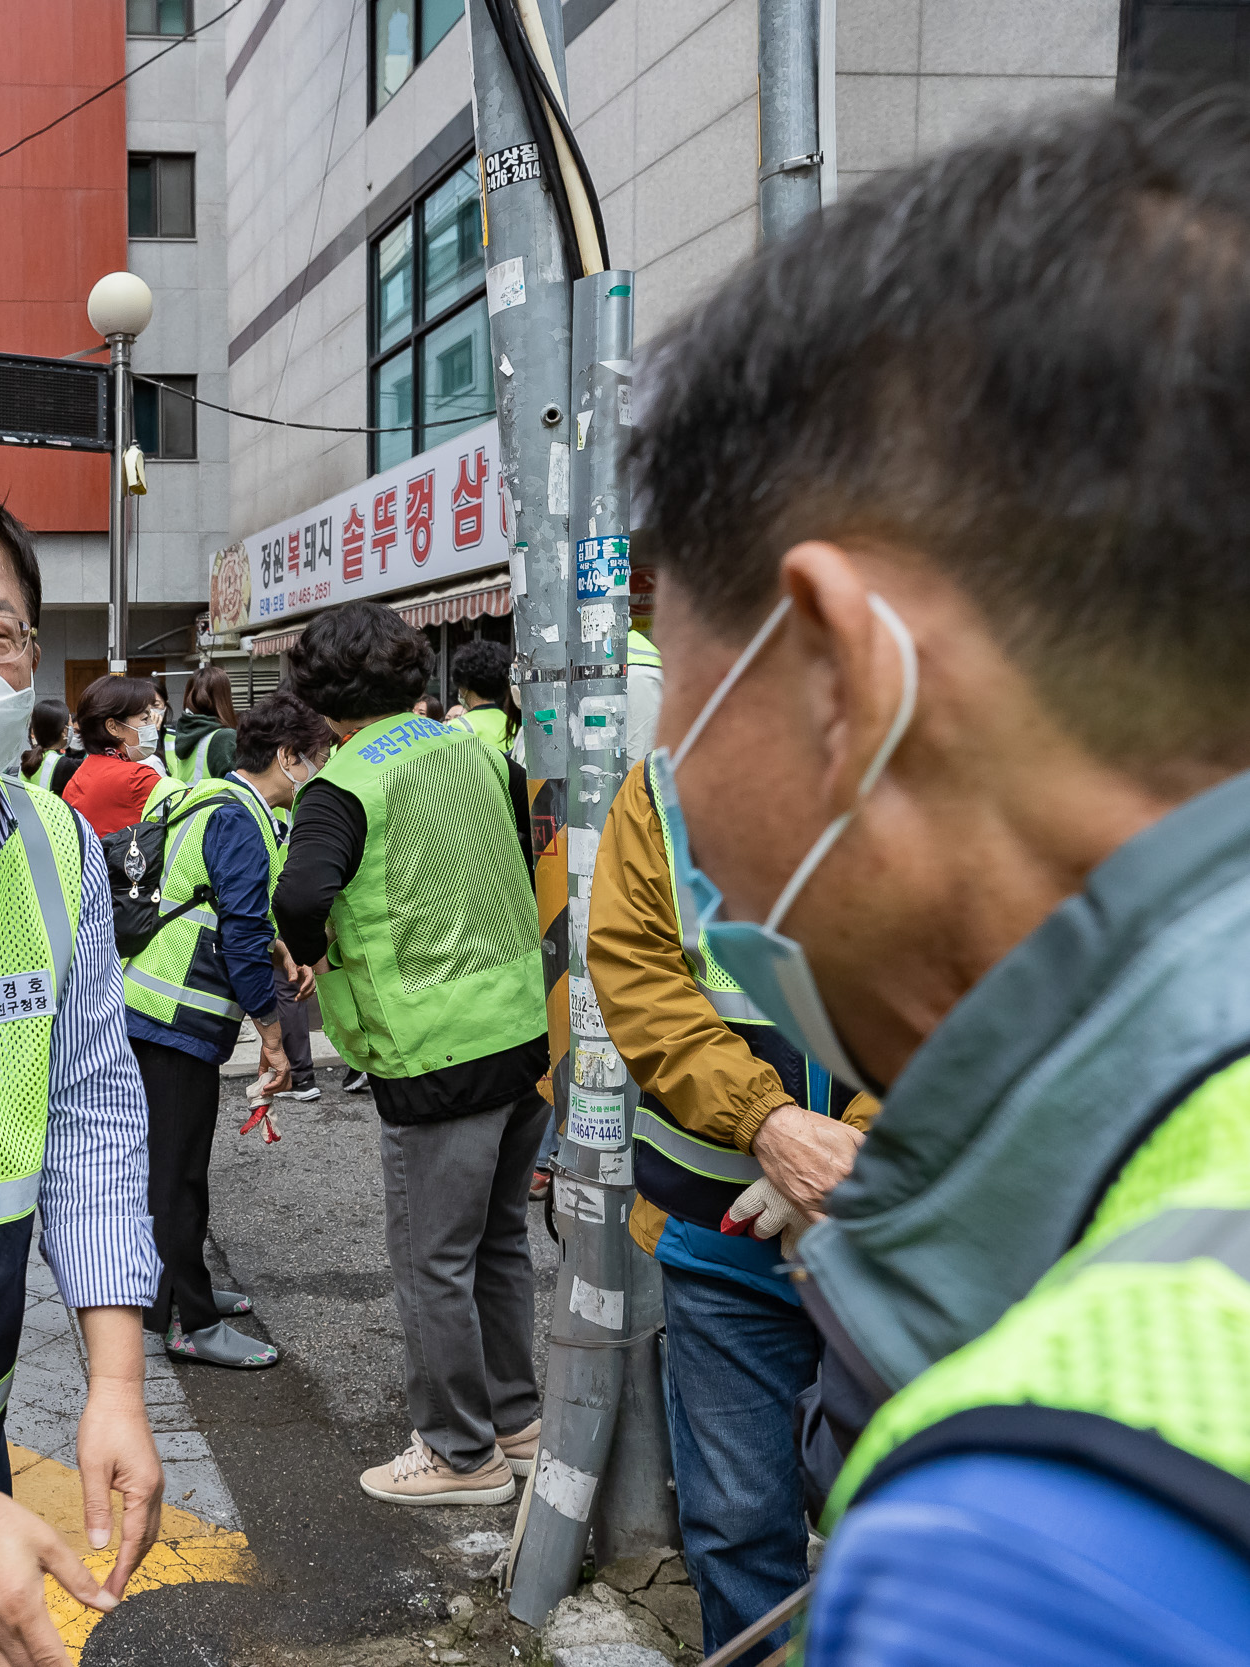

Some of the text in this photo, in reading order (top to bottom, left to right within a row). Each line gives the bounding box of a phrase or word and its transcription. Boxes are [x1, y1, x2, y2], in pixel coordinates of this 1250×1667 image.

[486, 143, 539, 173] 이삿짐
[451, 445, 508, 552] 삼
[287, 580, 331, 608] 02)465-2651
